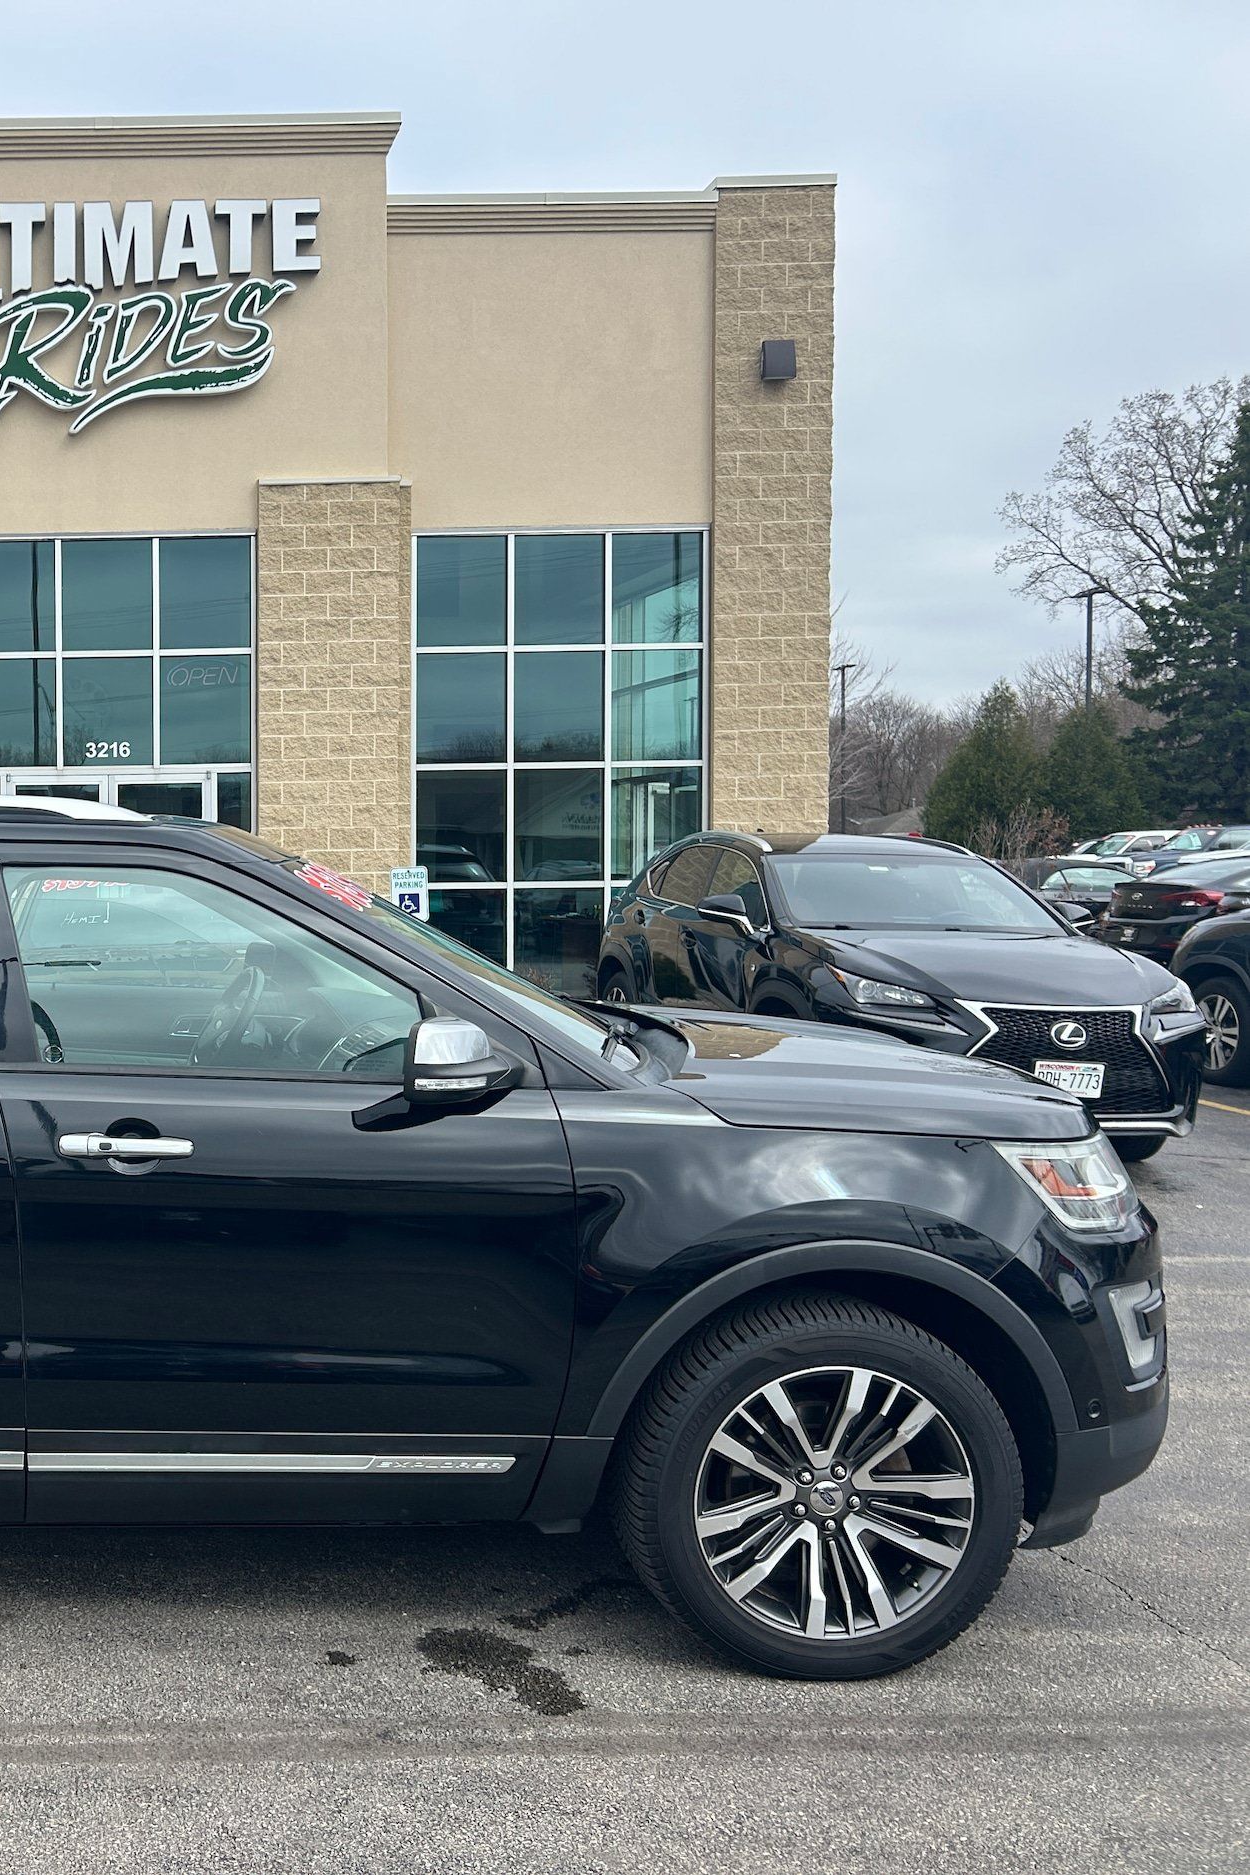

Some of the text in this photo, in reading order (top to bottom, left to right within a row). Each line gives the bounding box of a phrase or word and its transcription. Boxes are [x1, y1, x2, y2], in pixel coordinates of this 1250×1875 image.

[170, 666, 238, 686] OPEN
[85, 741, 131, 758] 3216
[392, 871, 425, 880] RESERVED
[394, 880, 424, 889] PARKING
[1039, 1063, 1075, 1071] WISCONSIN
